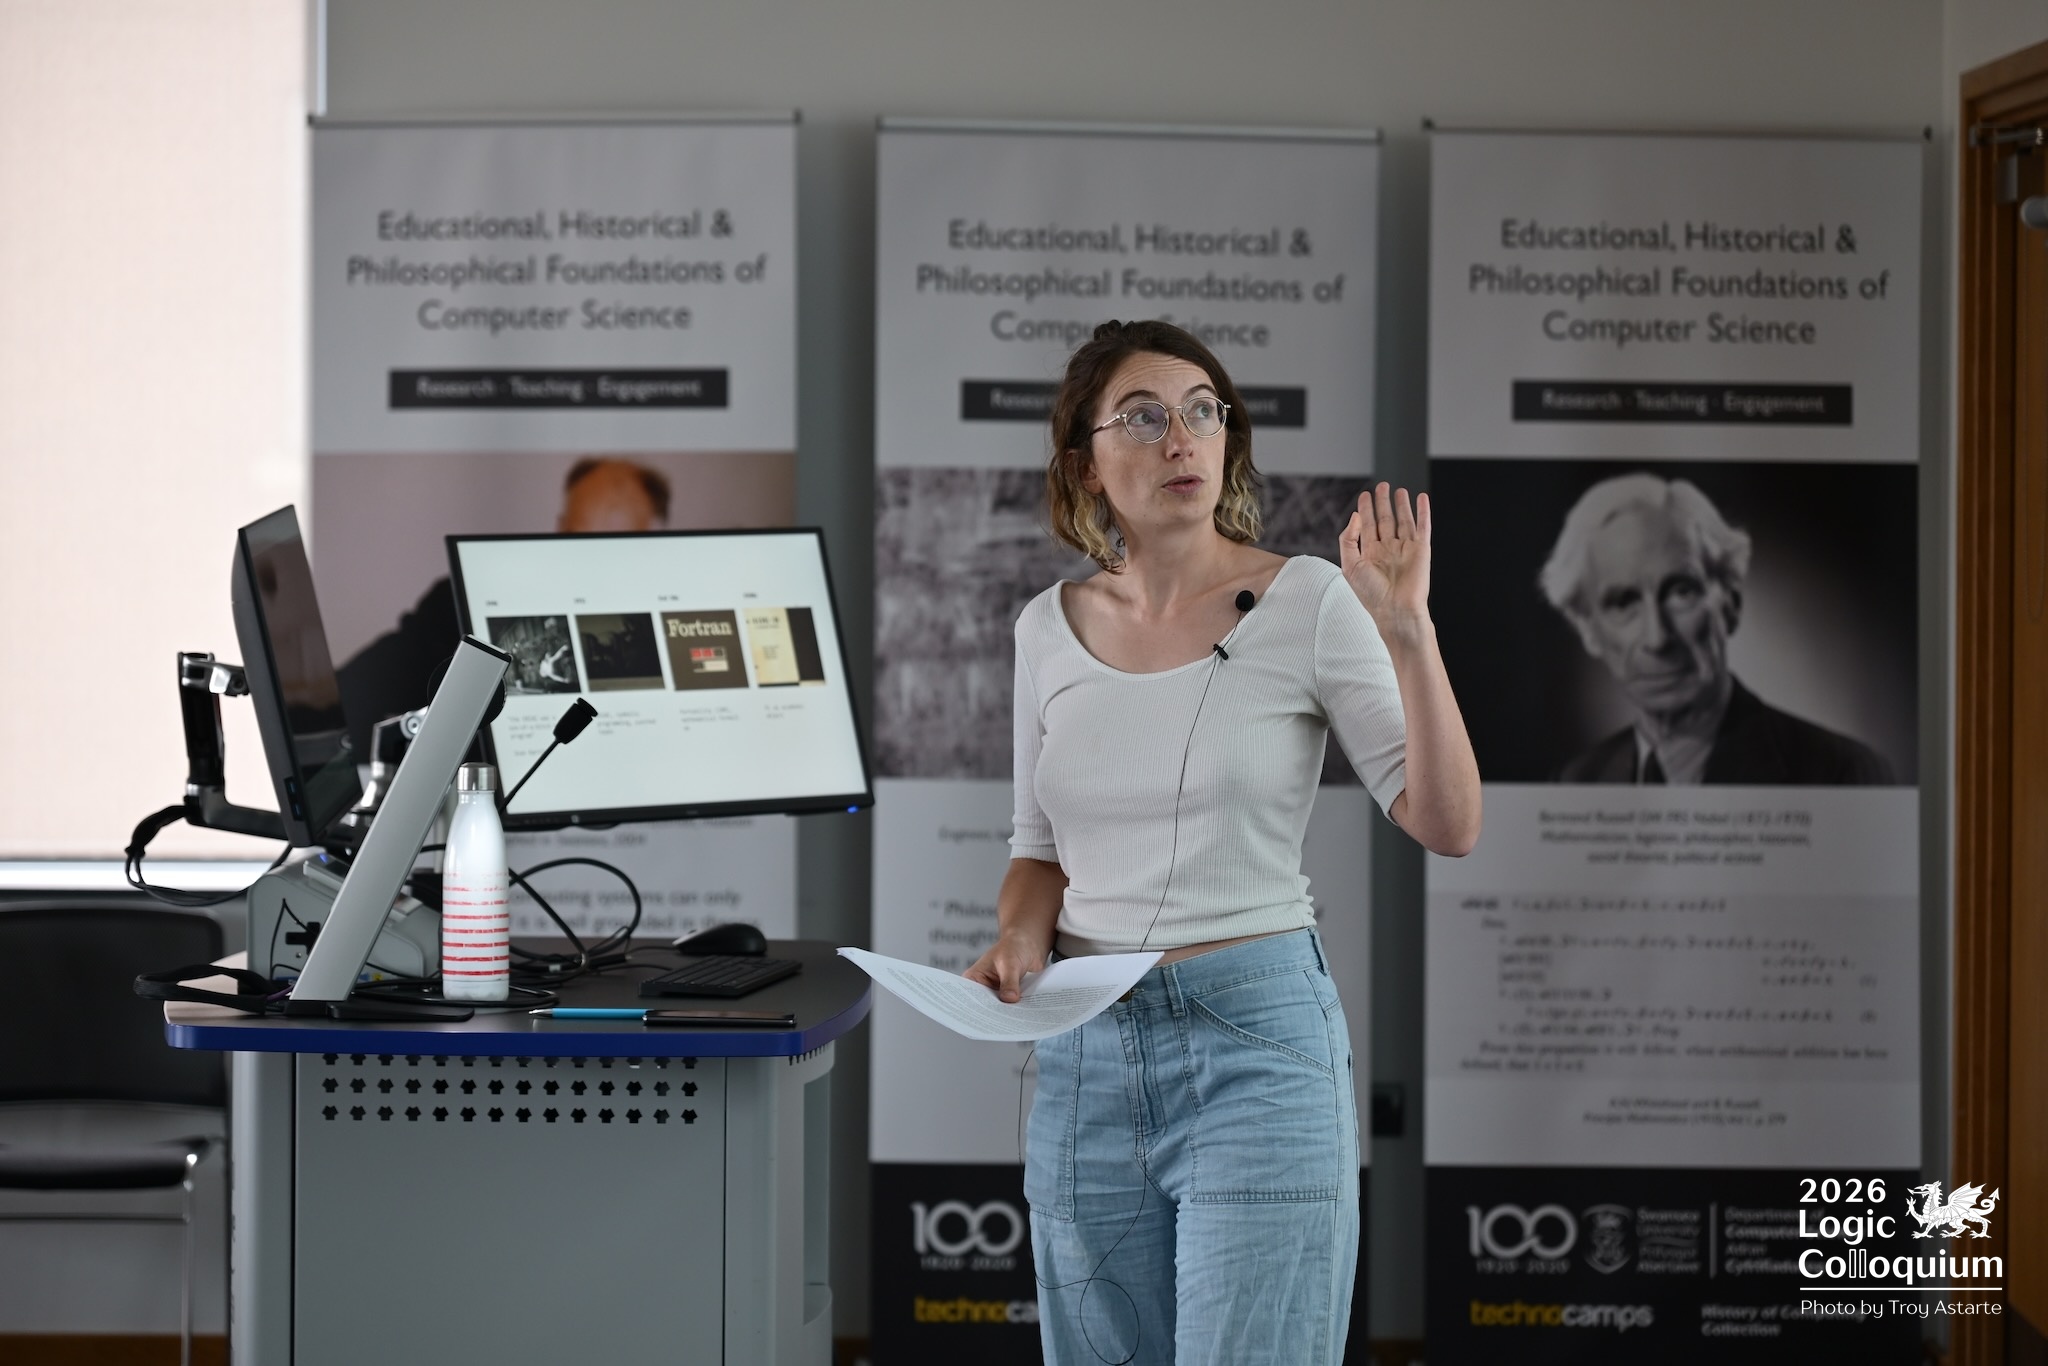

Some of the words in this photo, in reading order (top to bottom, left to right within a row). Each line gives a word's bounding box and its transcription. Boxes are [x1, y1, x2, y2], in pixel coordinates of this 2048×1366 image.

[377, 209, 552, 243] Educational,
[558, 209, 700, 240] Historical
[710, 208, 735, 239] &
[948, 218, 1127, 254] Educational,
[1135, 223, 1279, 257] Historical
[1290, 228, 1312, 257] &
[1501, 217, 1676, 253] Educational,
[1685, 221, 1824, 254] Historical
[1835, 223, 1858, 254] &
[347, 254, 537, 290] Philosophical
[546, 254, 725, 286] Foundations
[735, 252, 769, 284] of
[917, 263, 1110, 301] Philosophical
[1122, 267, 1301, 301] Foundations
[1313, 274, 1346, 303] of
[1469, 263, 1661, 301] Philosophical
[1672, 266, 1848, 300] Foundations
[1858, 269, 1891, 300] of
[417, 300, 570, 335] Computer
[581, 299, 692, 330] Science
[1542, 310, 1697, 348] Computer
[1707, 312, 1817, 345] Science
[666, 617, 734, 638] Fortran
[911, 1201, 1024, 1257] 100
[1467, 1202, 1579, 1259] 100
[1470, 1300, 1655, 1334] technocamps
